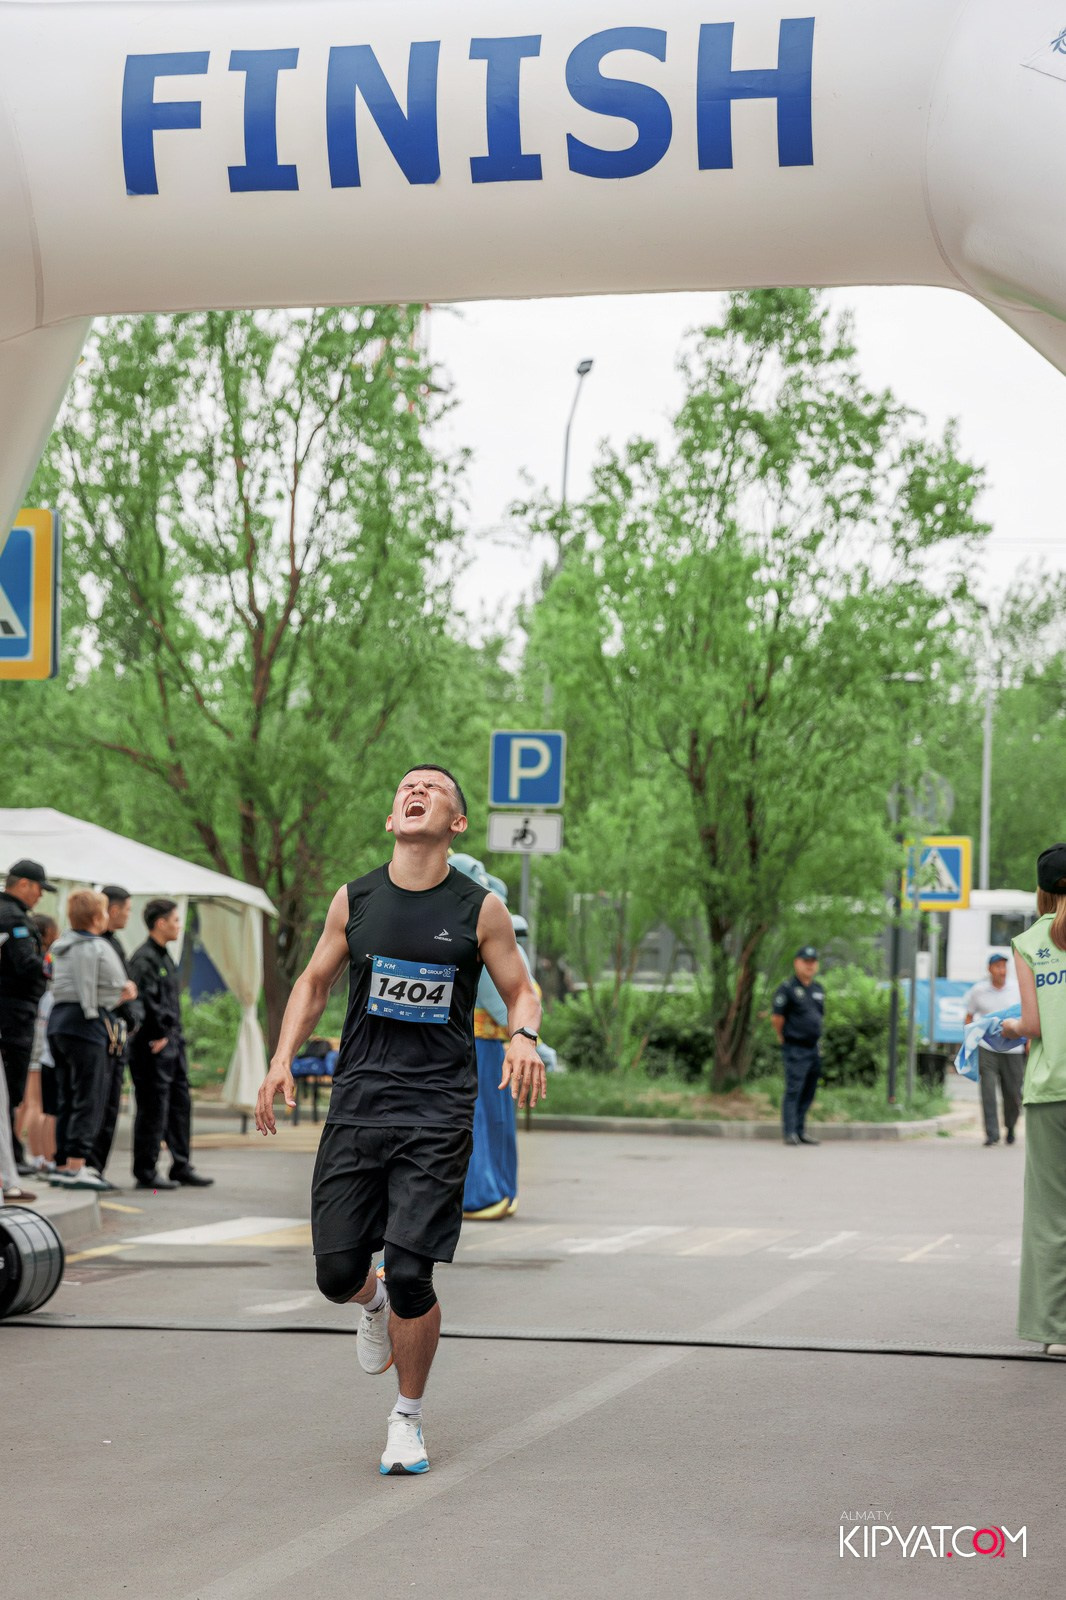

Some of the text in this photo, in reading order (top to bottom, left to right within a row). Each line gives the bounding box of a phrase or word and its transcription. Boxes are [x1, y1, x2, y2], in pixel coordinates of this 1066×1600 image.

[121, 16, 815, 196] FINISH
[509, 738, 551, 800] P
[383, 962, 396, 970] KM
[378, 978, 446, 1004] 1404
